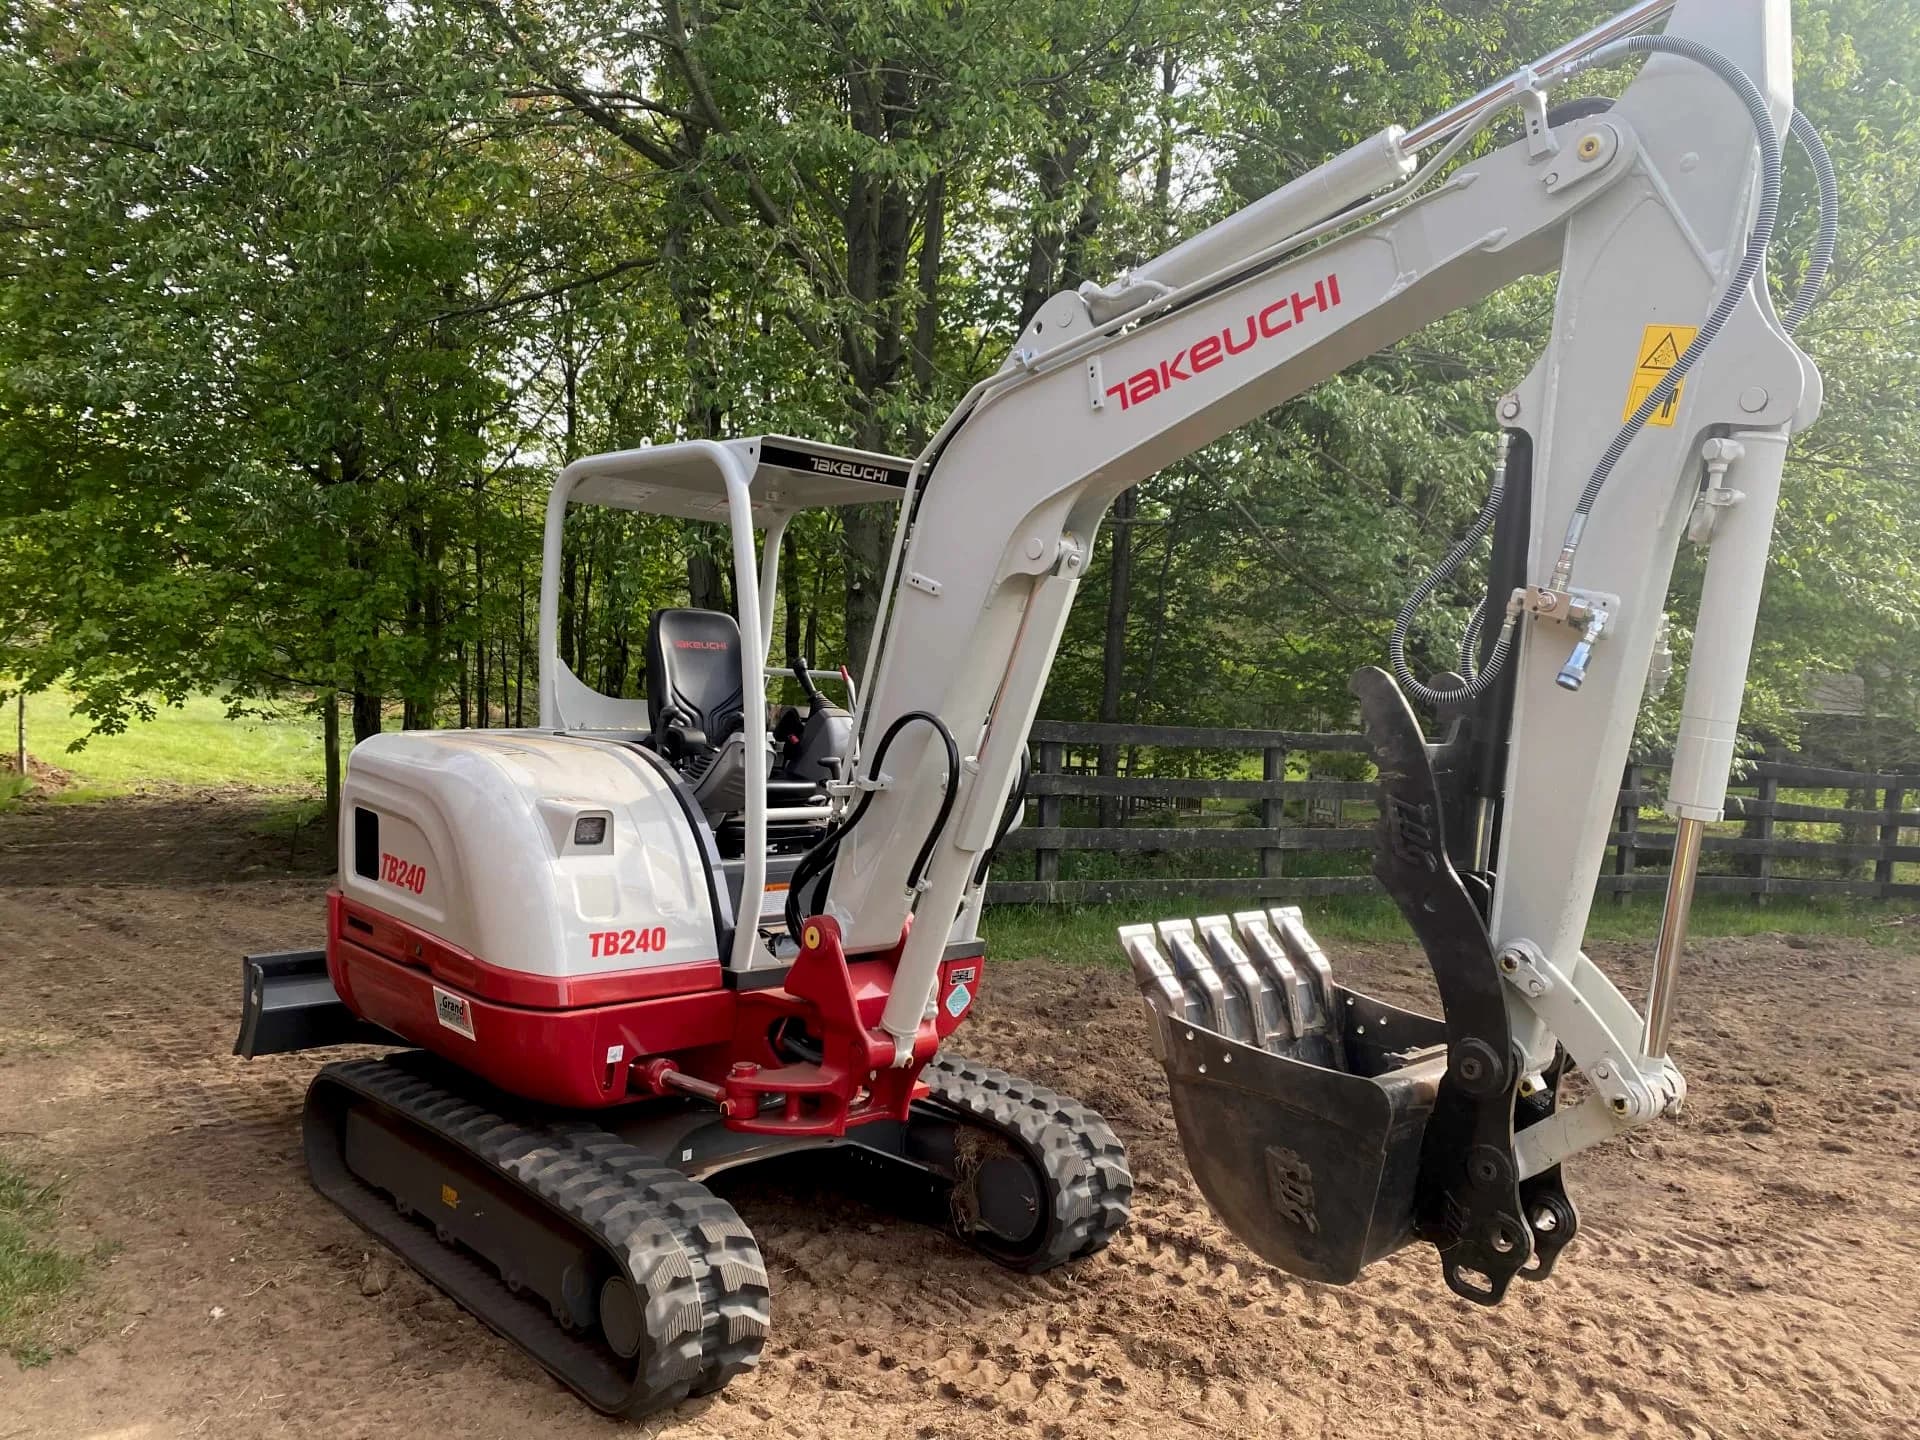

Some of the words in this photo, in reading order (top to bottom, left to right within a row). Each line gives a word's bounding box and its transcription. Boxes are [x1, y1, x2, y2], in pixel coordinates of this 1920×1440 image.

[381, 853, 426, 895] TB240
[589, 927, 666, 957] TB240
[442, 996, 464, 1016] Grand
